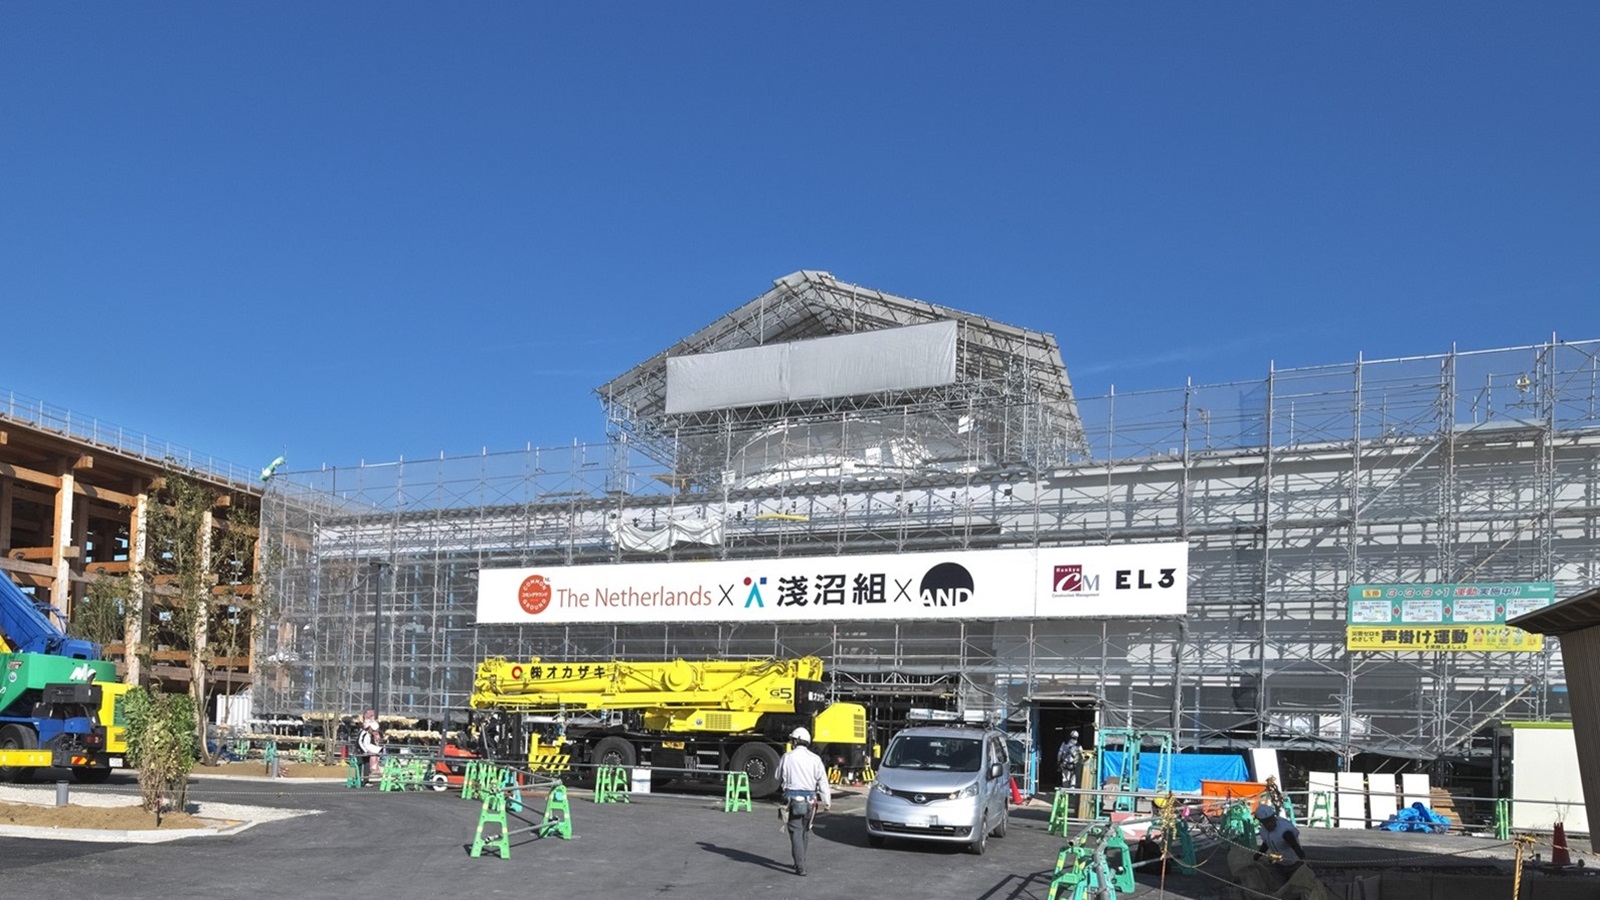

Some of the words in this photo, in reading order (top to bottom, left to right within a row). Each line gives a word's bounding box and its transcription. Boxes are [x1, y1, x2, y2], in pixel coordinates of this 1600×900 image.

[522, 579, 547, 591] COMMON
[1115, 568, 1177, 589] EL3
[556, 587, 590, 608] The
[595, 585, 712, 607] Netherlands
[776, 573, 887, 607] 淺沼組
[920, 588, 974, 607] AND
[522, 599, 547, 610] GROUND
[1381, 629, 1468, 644] 声掛け運動
